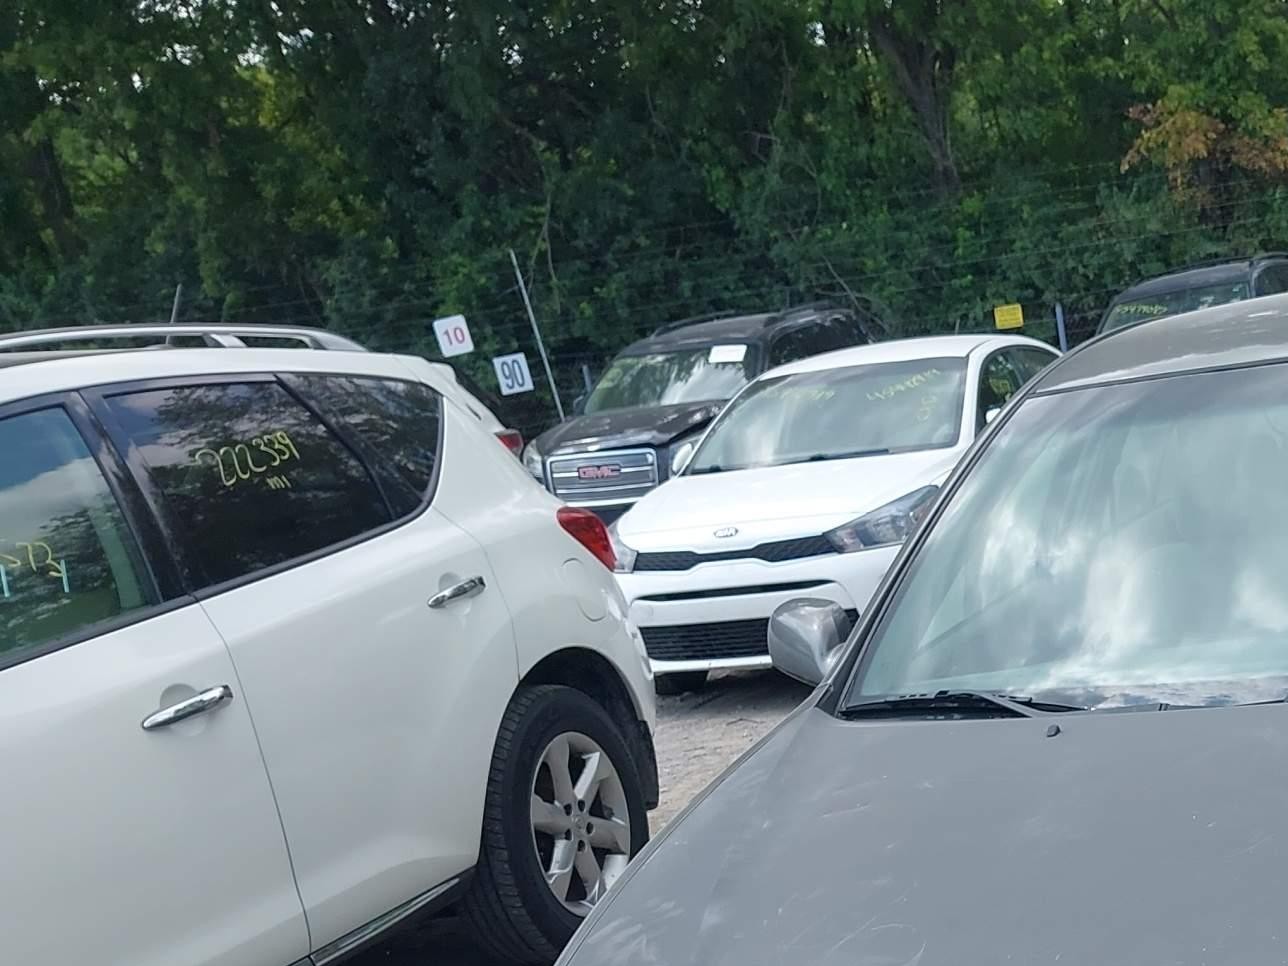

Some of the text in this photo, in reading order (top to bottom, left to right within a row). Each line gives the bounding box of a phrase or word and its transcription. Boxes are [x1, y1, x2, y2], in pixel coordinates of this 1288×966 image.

[443, 326, 466, 346] 10
[500, 359, 525, 390] 90
[578, 464, 621, 479] GMC
